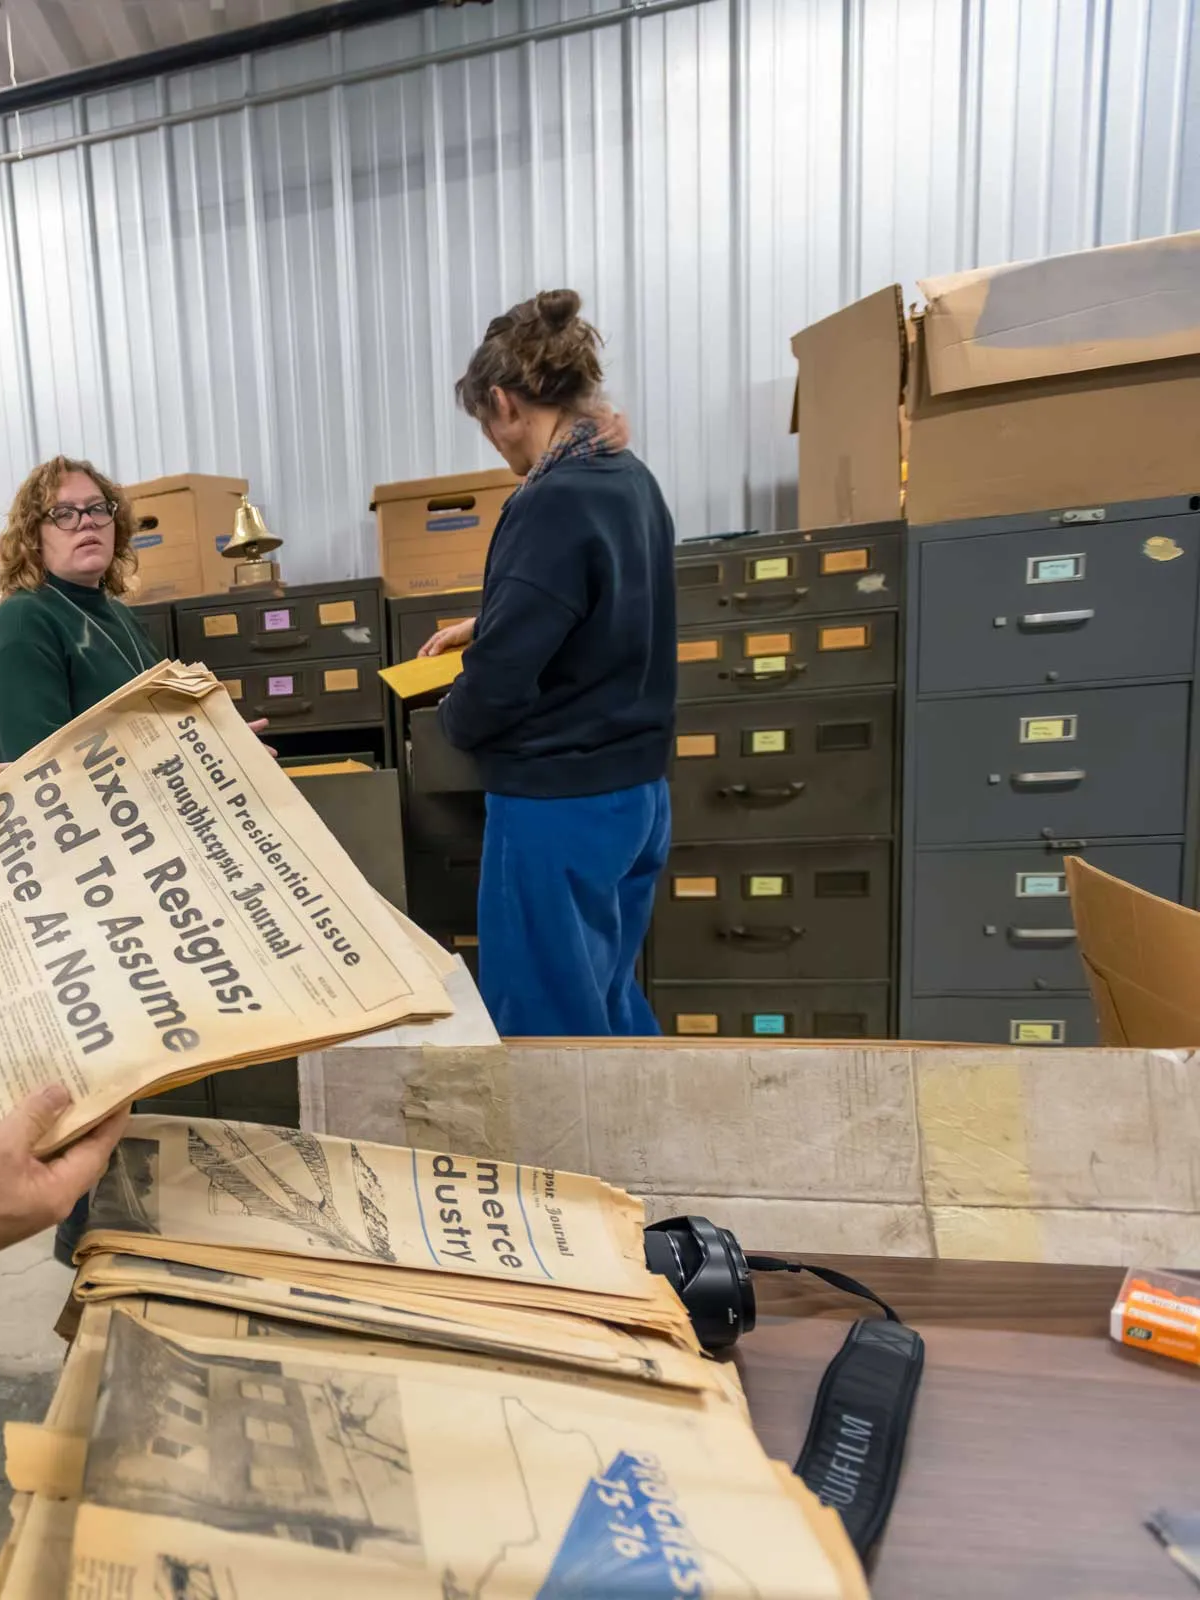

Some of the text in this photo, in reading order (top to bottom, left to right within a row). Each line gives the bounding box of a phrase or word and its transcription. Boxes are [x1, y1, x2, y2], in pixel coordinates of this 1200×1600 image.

[23, 758, 200, 1053] Ford To Assume
[74, 728, 262, 1014] Nixon Resigns;
[151, 754, 305, 960] Poughkeepsie Journal
[177, 715, 237, 791] Special
[226, 793, 323, 907] Presidential
[310, 907, 361, 967] Issue
[24, 912, 72, 948] At
[45, 949, 114, 1055] Noon
[432, 1154, 477, 1262] dustry
[477, 1161, 523, 1268] merce
[544, 1204, 574, 1256] Journal
[628, 1450, 708, 1600] PROGRES
